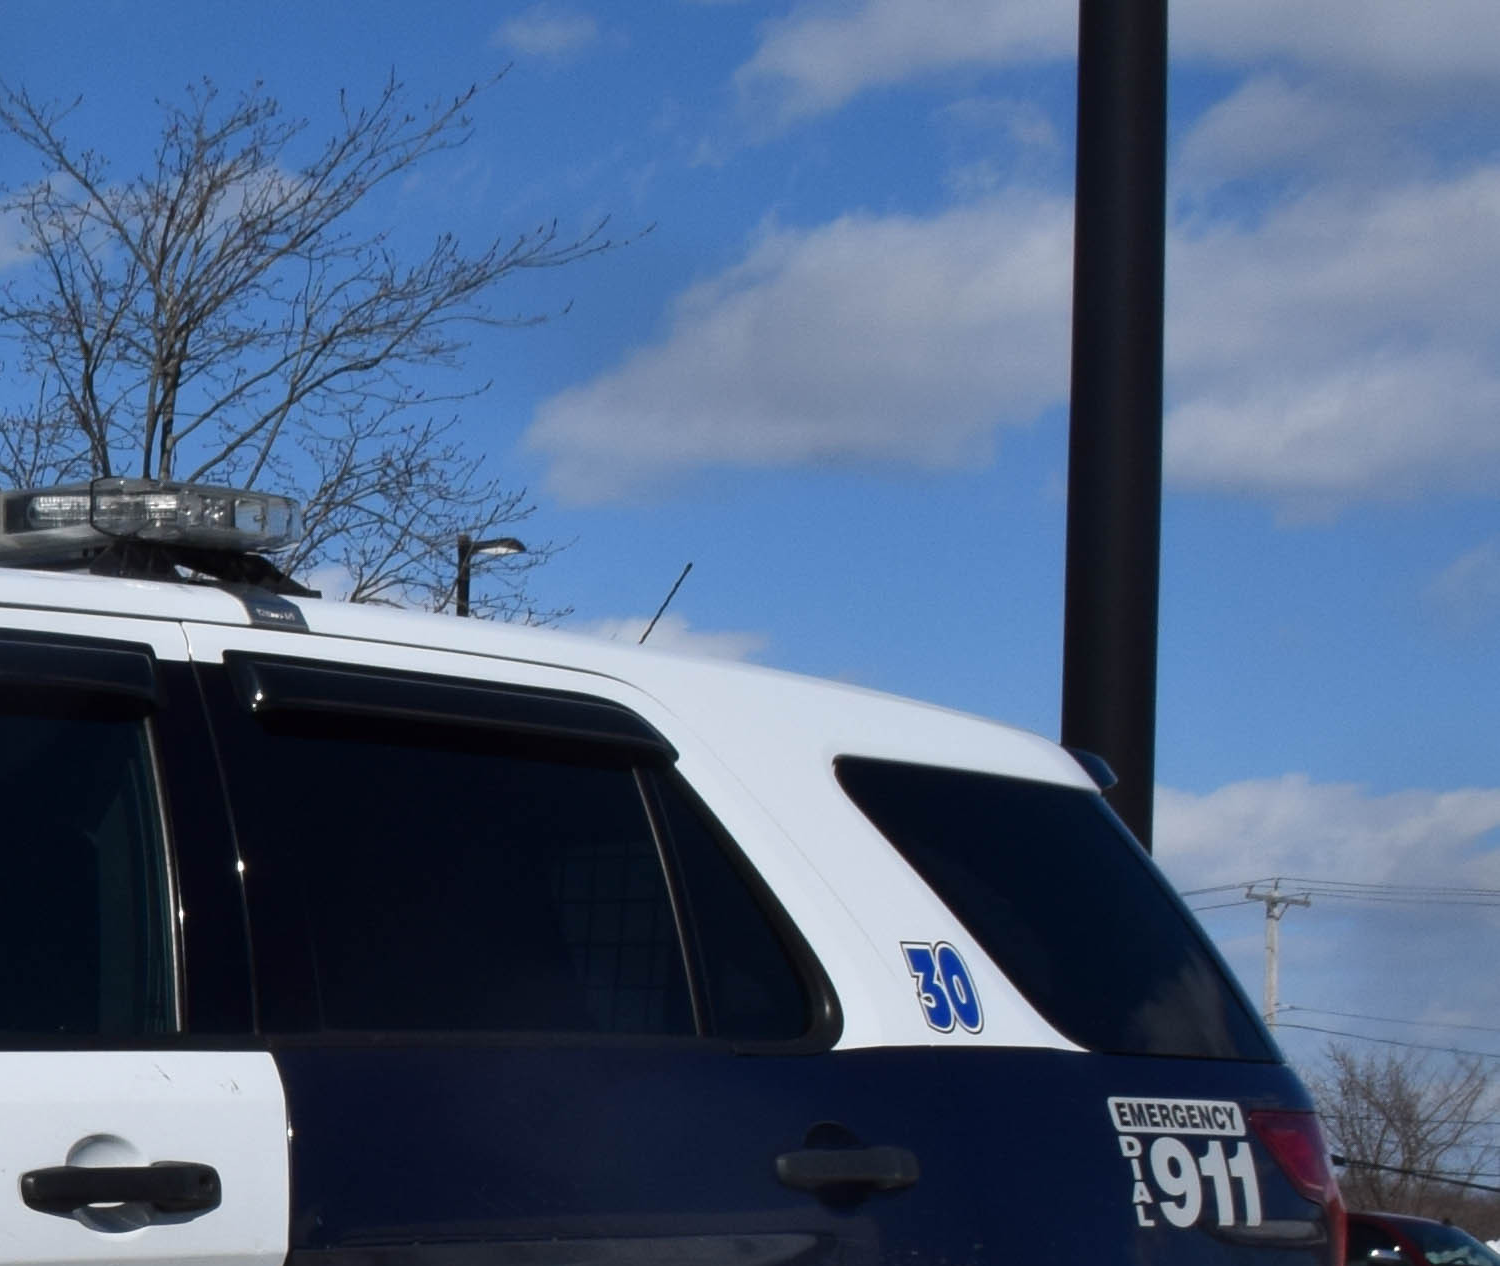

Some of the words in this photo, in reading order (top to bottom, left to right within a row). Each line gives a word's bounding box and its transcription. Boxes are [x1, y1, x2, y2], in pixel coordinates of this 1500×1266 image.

[900, 941, 984, 1035] 30
[1115, 1102, 1237, 1130] EMERGENCY
[1118, 1136, 1155, 1226] DIAL
[1150, 1136, 1262, 1228] 911
